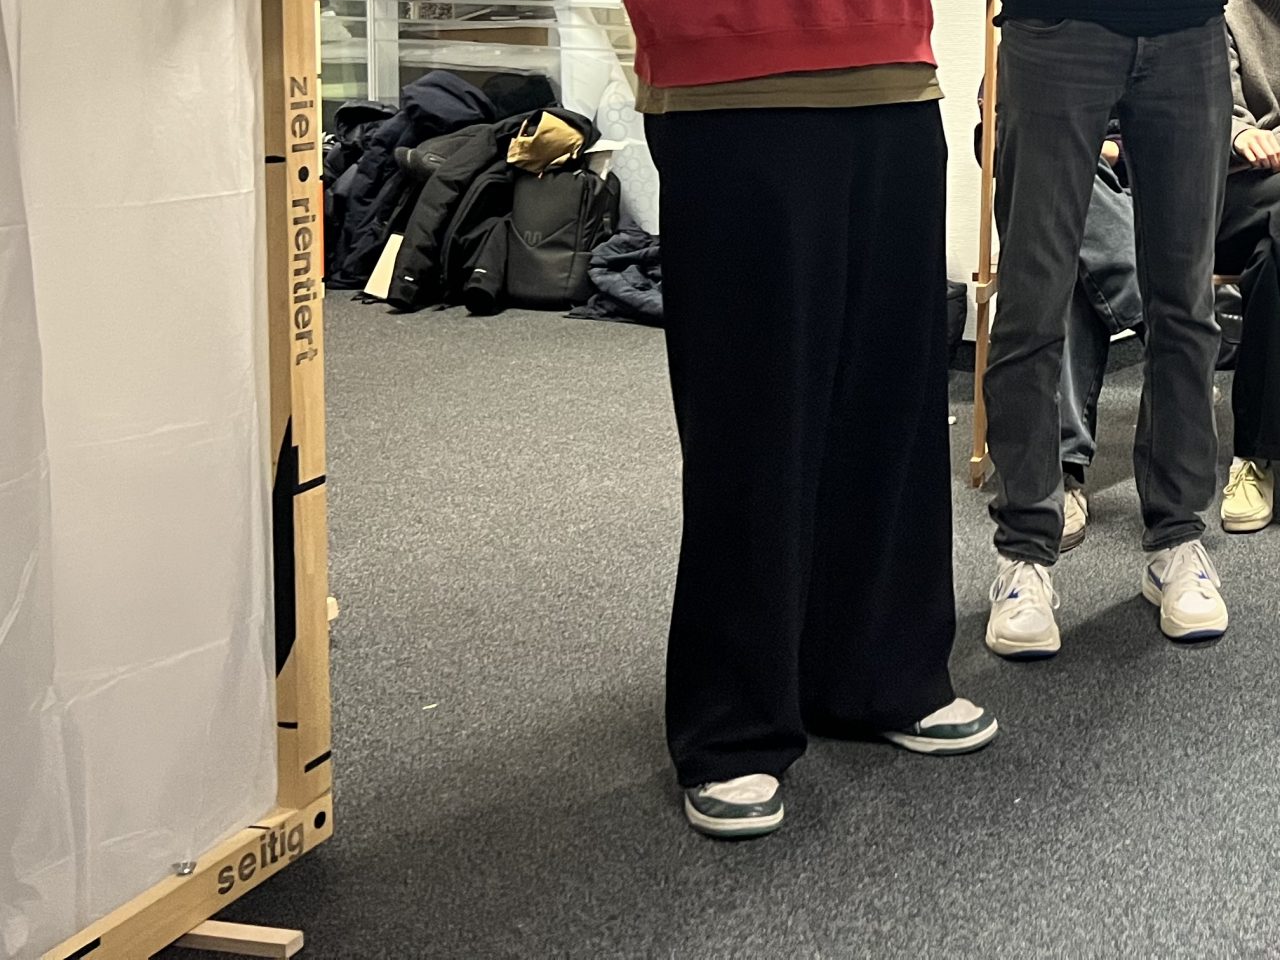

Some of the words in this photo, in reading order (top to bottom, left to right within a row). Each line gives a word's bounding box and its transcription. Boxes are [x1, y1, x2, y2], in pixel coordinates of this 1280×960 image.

[289, 76, 315, 153] ziel
[291, 197, 318, 366] rientiert
[217, 821, 304, 895] seitig
